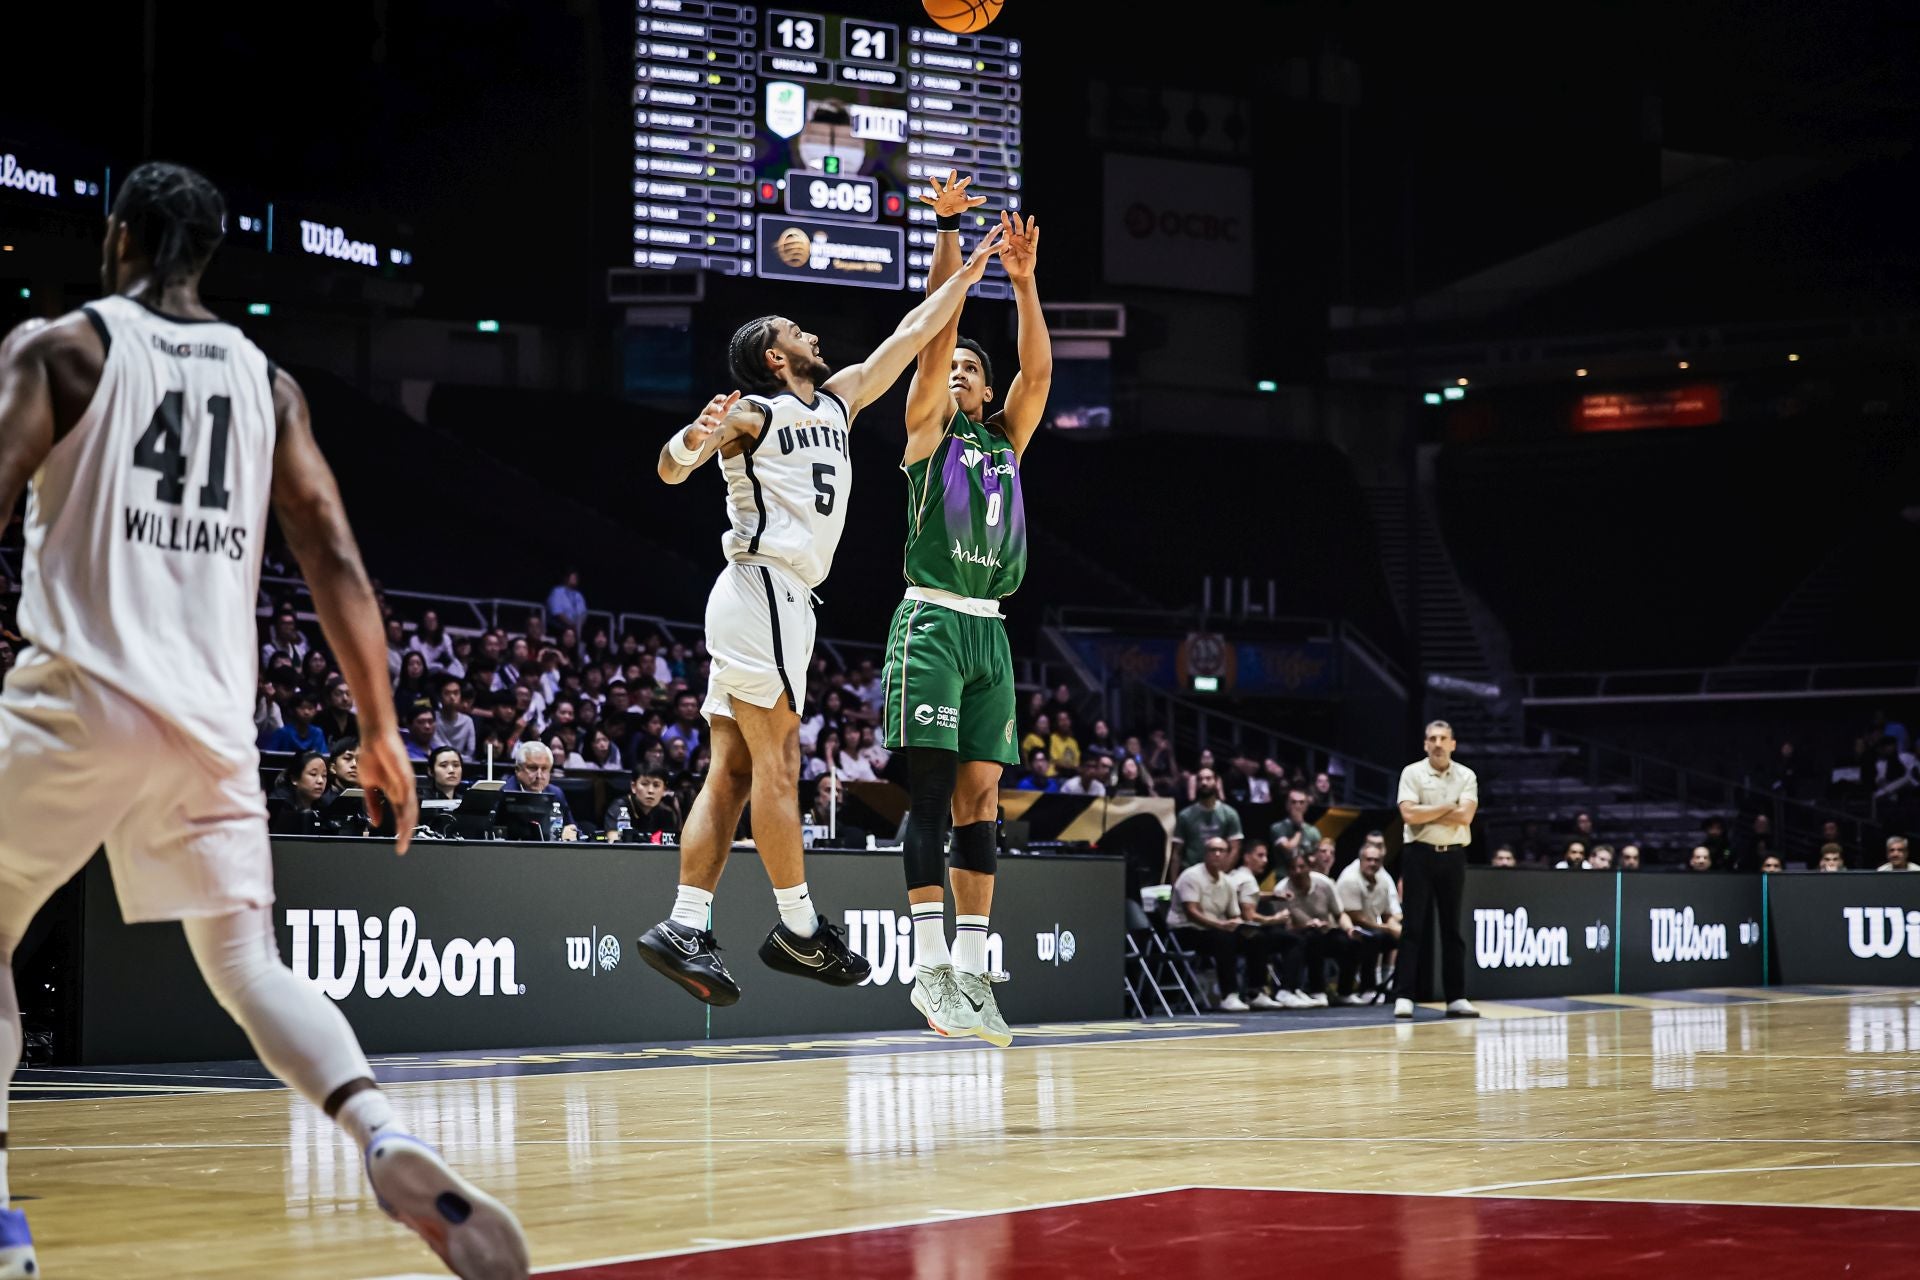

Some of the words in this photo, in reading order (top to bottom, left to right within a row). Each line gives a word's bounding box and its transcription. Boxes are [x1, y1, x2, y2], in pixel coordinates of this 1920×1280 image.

[777, 18, 815, 50] 13
[850, 28, 886, 60] 21
[809, 180, 872, 213] 9:05
[300, 219, 378, 266] Wilson
[1160, 210, 1241, 243] OCBC
[133, 390, 231, 511] 41
[812, 463, 836, 517] 5
[985, 492, 1001, 526] 0
[125, 506, 247, 561] WILLIAMS
[285, 906, 519, 1000] Wilson
[1474, 906, 1571, 969] Wilson
[1650, 906, 1729, 963] Wilson
